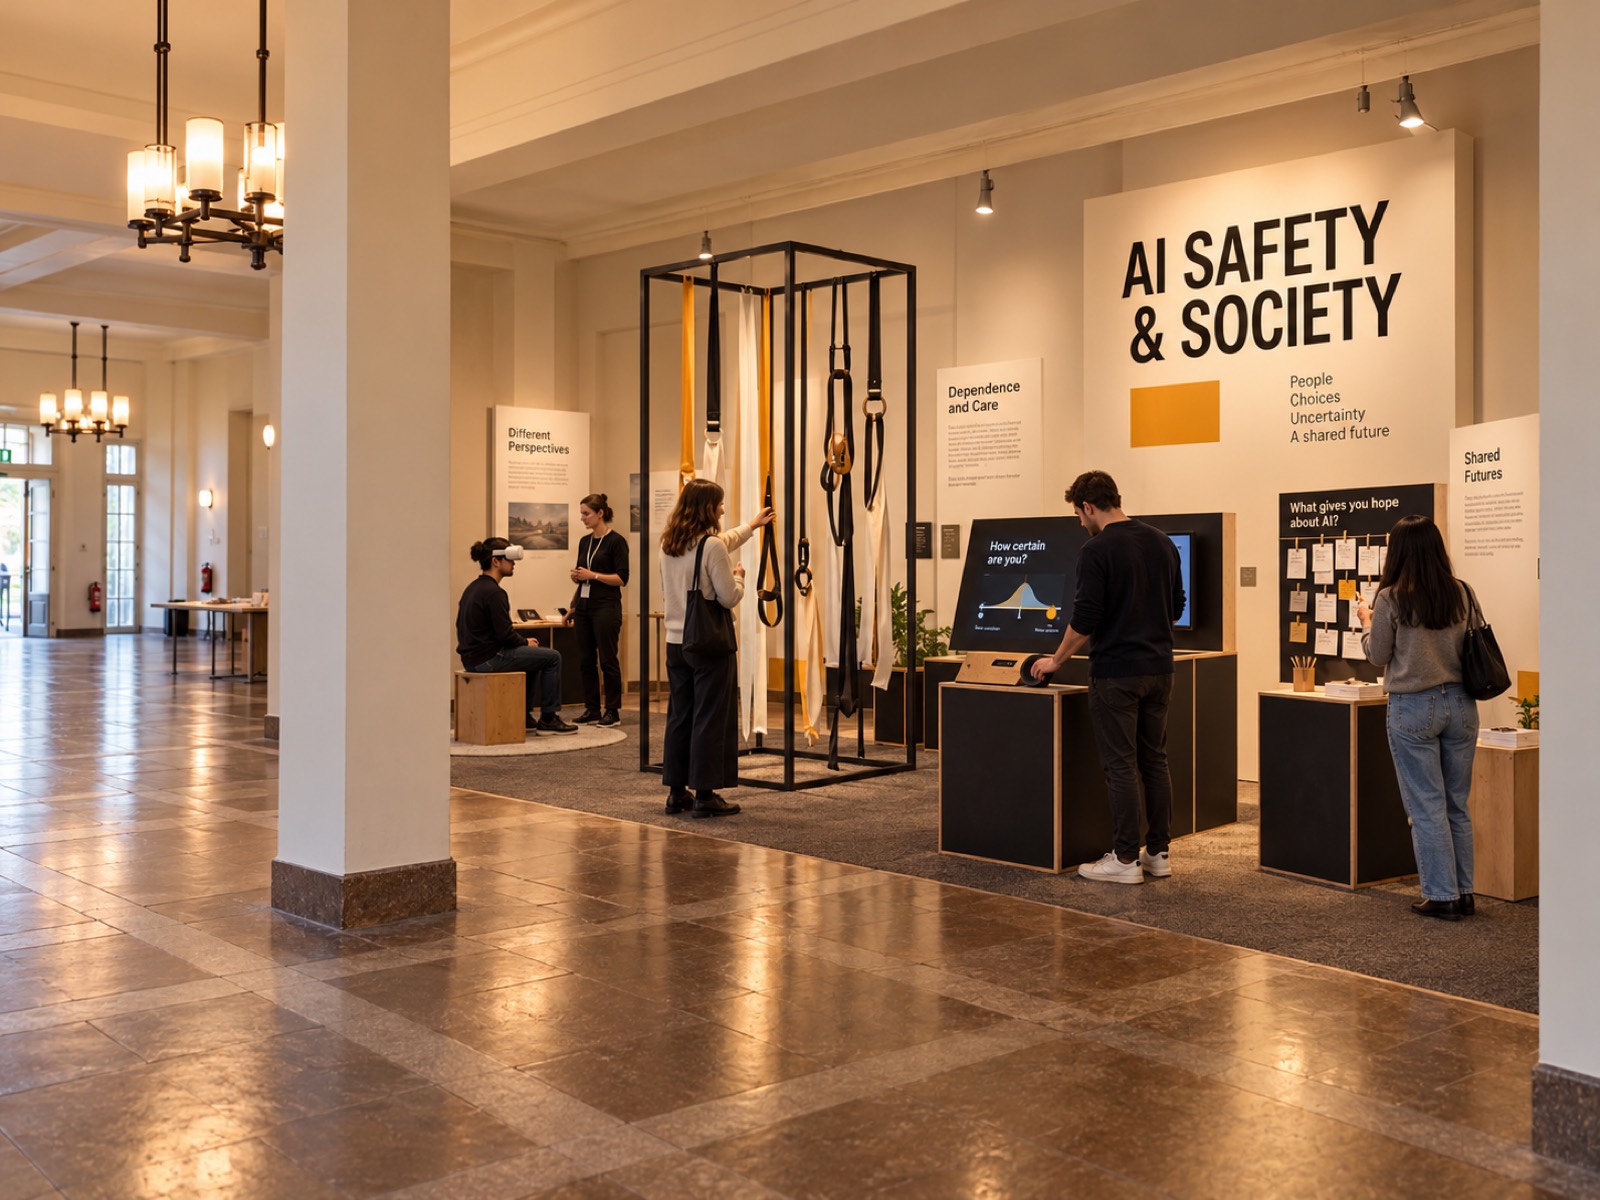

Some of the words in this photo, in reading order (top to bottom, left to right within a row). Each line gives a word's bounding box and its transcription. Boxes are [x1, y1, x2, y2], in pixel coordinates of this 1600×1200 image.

[1122, 237, 1165, 298] AI
[1184, 200, 1390, 289] SAFETY
[1130, 306, 1165, 363] &
[1181, 273, 1402, 358] SOCIETY
[1290, 373, 1333, 389] People
[948, 382, 1021, 399] Dependence
[948, 401, 969, 414] and
[972, 400, 999, 412] Care
[1290, 391, 1341, 407] Choices
[1290, 408, 1366, 425] Uncertainty
[508, 428, 551, 440] Different
[1290, 430, 1299, 443] A
[1303, 426, 1346, 442] shared
[1350, 424, 1390, 439] future
[508, 441, 570, 455] Perspectives
[1464, 447, 1501, 465] Shared
[1464, 467, 1503, 483] Futures
[1290, 502, 1317, 514] What
[1319, 500, 1347, 514] gives
[1349, 501, 1369, 513] you
[1371, 497, 1399, 510] hope
[1290, 516, 1319, 528] about
[1322, 515, 1339, 527] AI?
[990, 541, 1012, 551] How
[1012, 540, 1046, 551] certain
[987, 556, 1002, 565] are
[1003, 554, 1028, 567] you?
